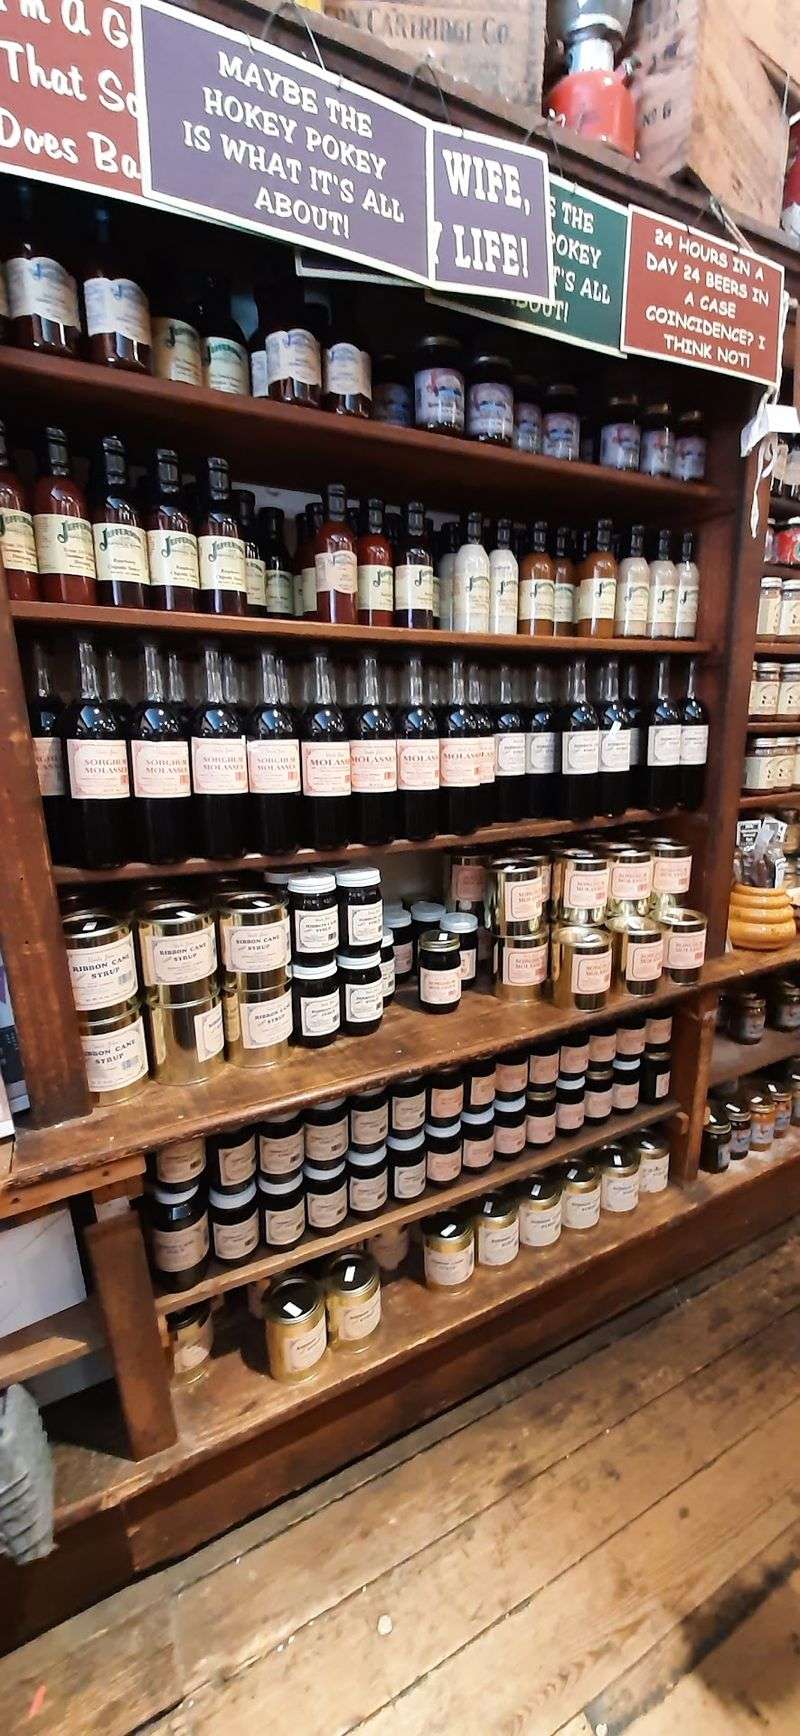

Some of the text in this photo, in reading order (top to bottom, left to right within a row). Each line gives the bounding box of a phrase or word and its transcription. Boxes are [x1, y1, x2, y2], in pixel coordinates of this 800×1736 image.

[0, 40, 88, 101] That
[218, 52, 373, 138] MAYBE THE
[0, 108, 79, 164] Does
[203, 87, 387, 180] HOKEY POKEY
[183, 120, 405, 223] IS WHAT IT'S ALL
[442, 149, 531, 216] WIFE,
[254, 187, 350, 238] ABOUT!
[562, 201, 595, 234] THE
[452, 223, 530, 279] LIFE!
[654, 228, 765, 282] 24 HOURS IN A
[553, 265, 611, 305] T'S ALL
[646, 251, 769, 307] DAY 24 BEERS IN
[513, 300, 569, 323] BOUT!
[645, 305, 766, 350] COINCIDENCE? I
[684, 291, 736, 319] A CASE
[664, 333, 712, 359] THINK
[72, 961, 108, 973] RIBBON
[91, 966, 121, 979] SYRUP
[160, 948, 187, 956] RIBBON
[95, 1053, 125, 1065] SYRUP
